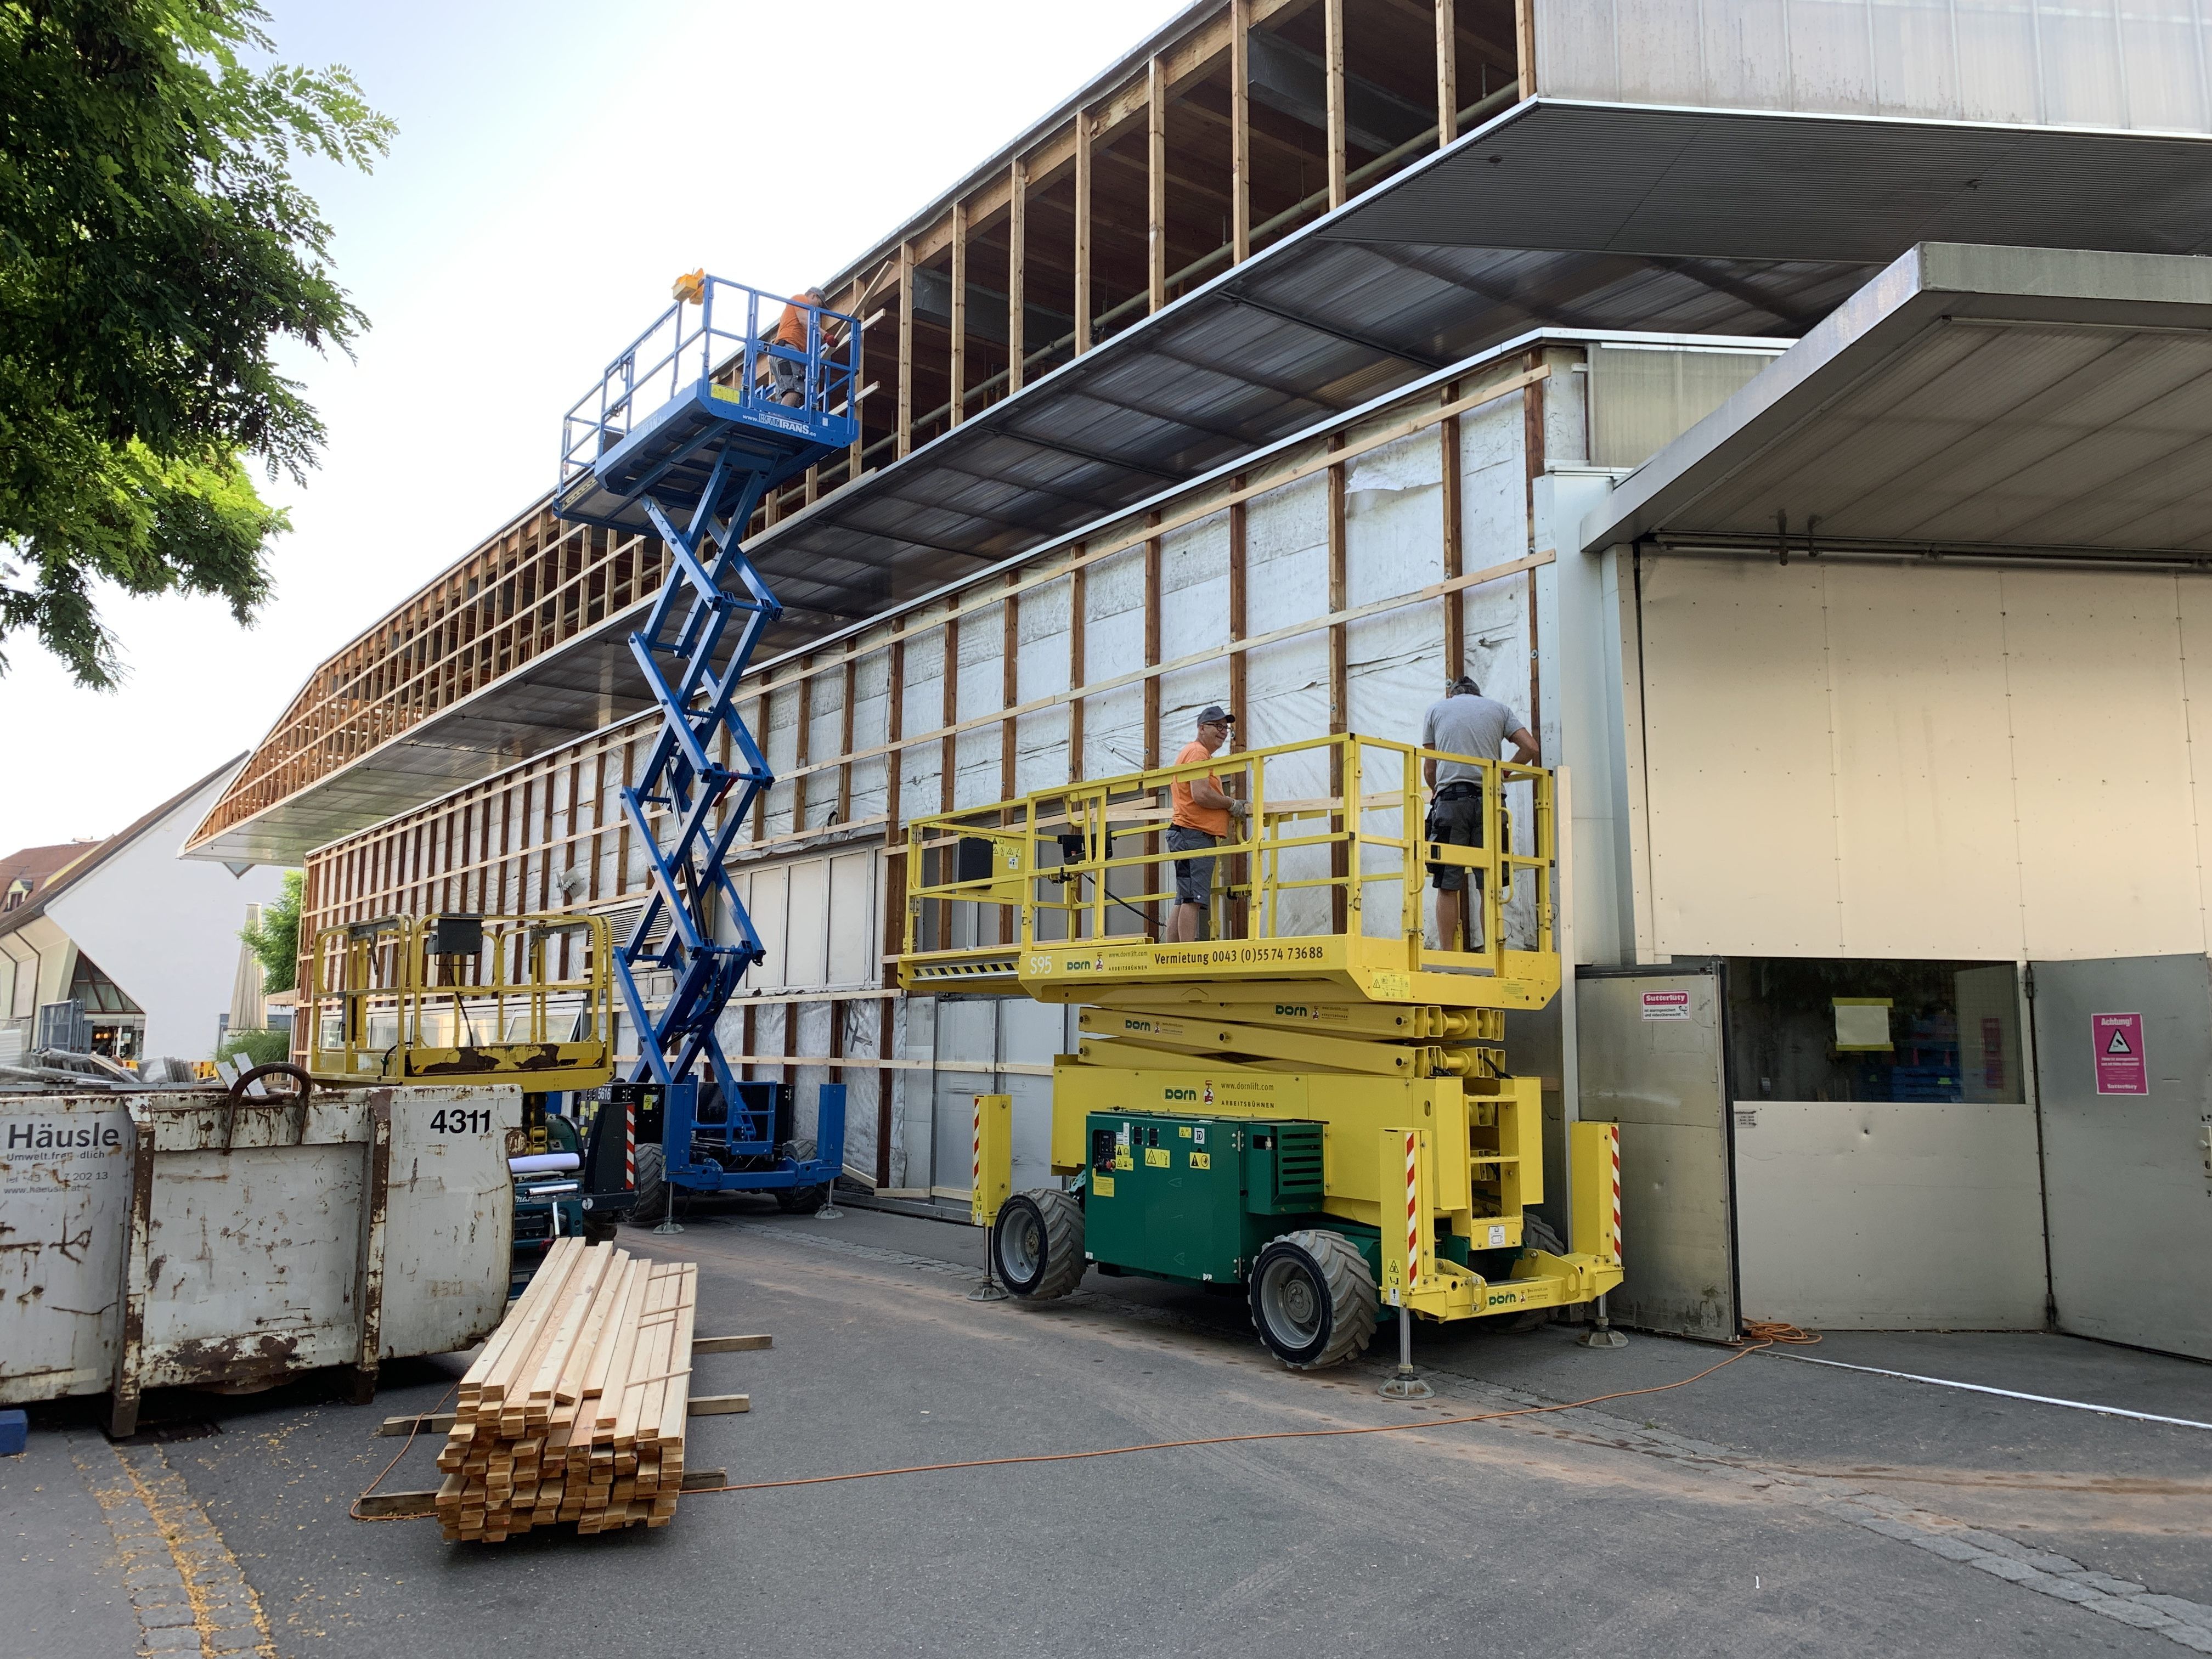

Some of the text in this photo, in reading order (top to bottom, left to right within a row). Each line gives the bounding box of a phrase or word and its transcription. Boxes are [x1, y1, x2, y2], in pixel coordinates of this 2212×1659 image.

[1030, 955, 1052, 975] S95
[1155, 952, 1209, 966] Vermietung
[1212, 950, 1237, 962] 0043
[2101, 1018, 2132, 1027] Achtung!
[1221, 1081, 1274, 1091] www.dornlift.com
[597, 1087, 611, 1101] 5616
[1221, 1100, 1274, 1108] ARBEITSBÜHNEN
[430, 1109, 490, 1134] 4311
[8, 1122, 120, 1149] Häusle
[95, 1171, 108, 1180] 13
